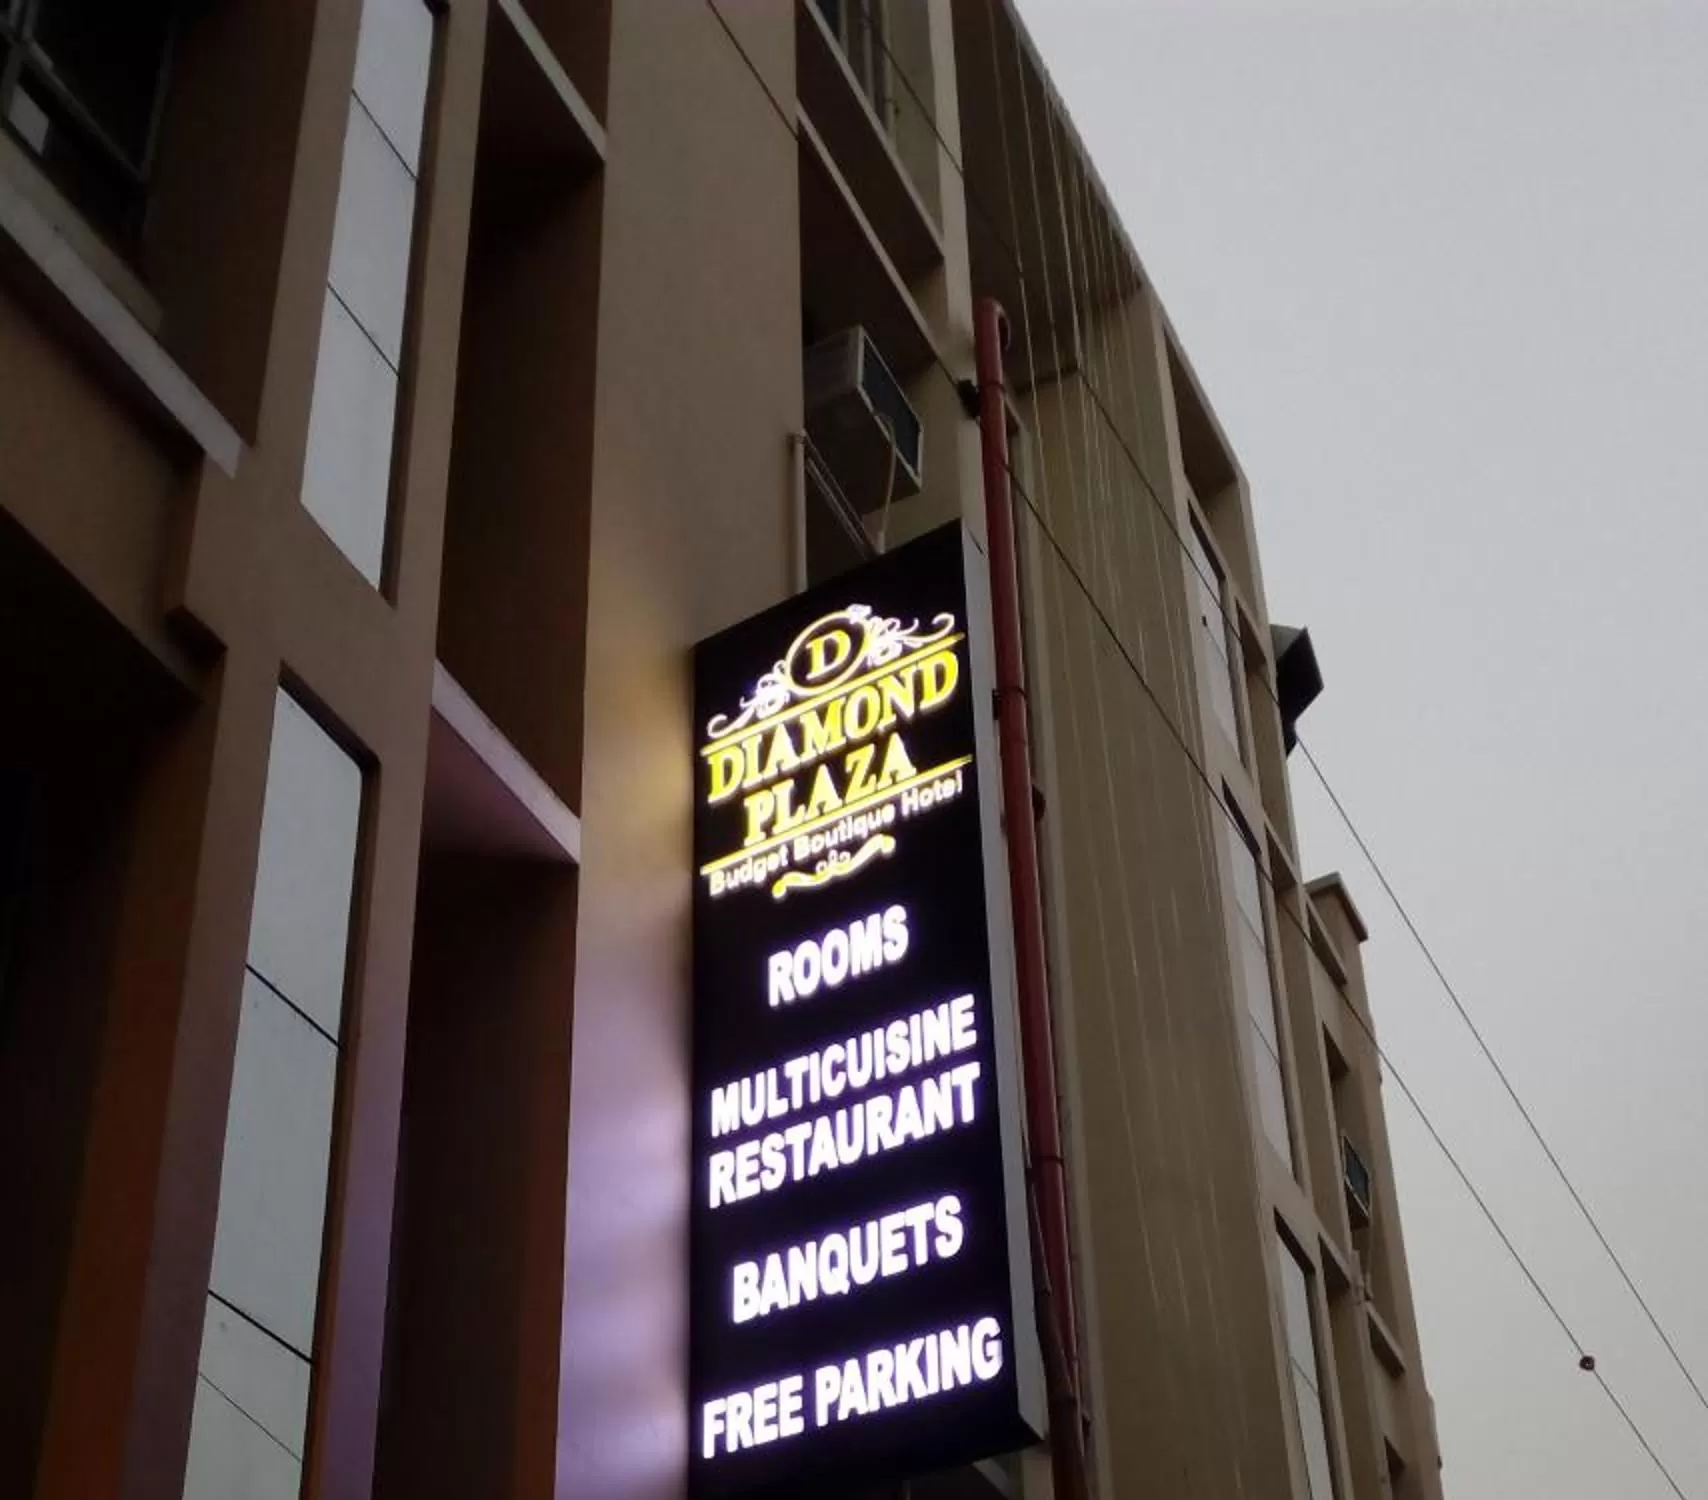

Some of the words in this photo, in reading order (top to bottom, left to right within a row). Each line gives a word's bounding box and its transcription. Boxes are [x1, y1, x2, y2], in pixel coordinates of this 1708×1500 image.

[806, 629, 851, 679] D
[707, 650, 959, 803] DIAMOND
[744, 733, 917, 847] PLAZA
[709, 845, 789, 896] Budget
[793, 804, 896, 861] Boutique
[902, 770, 963, 817] Hotel
[767, 904, 909, 1006] ROOMS
[711, 994, 977, 1137] MULTICUISINE
[708, 1062, 981, 1208] RESTAURANT
[731, 1196, 963, 1324] BANQUETS
[702, 1376, 804, 1459] FREE
[814, 1316, 1002, 1427] PARKING
